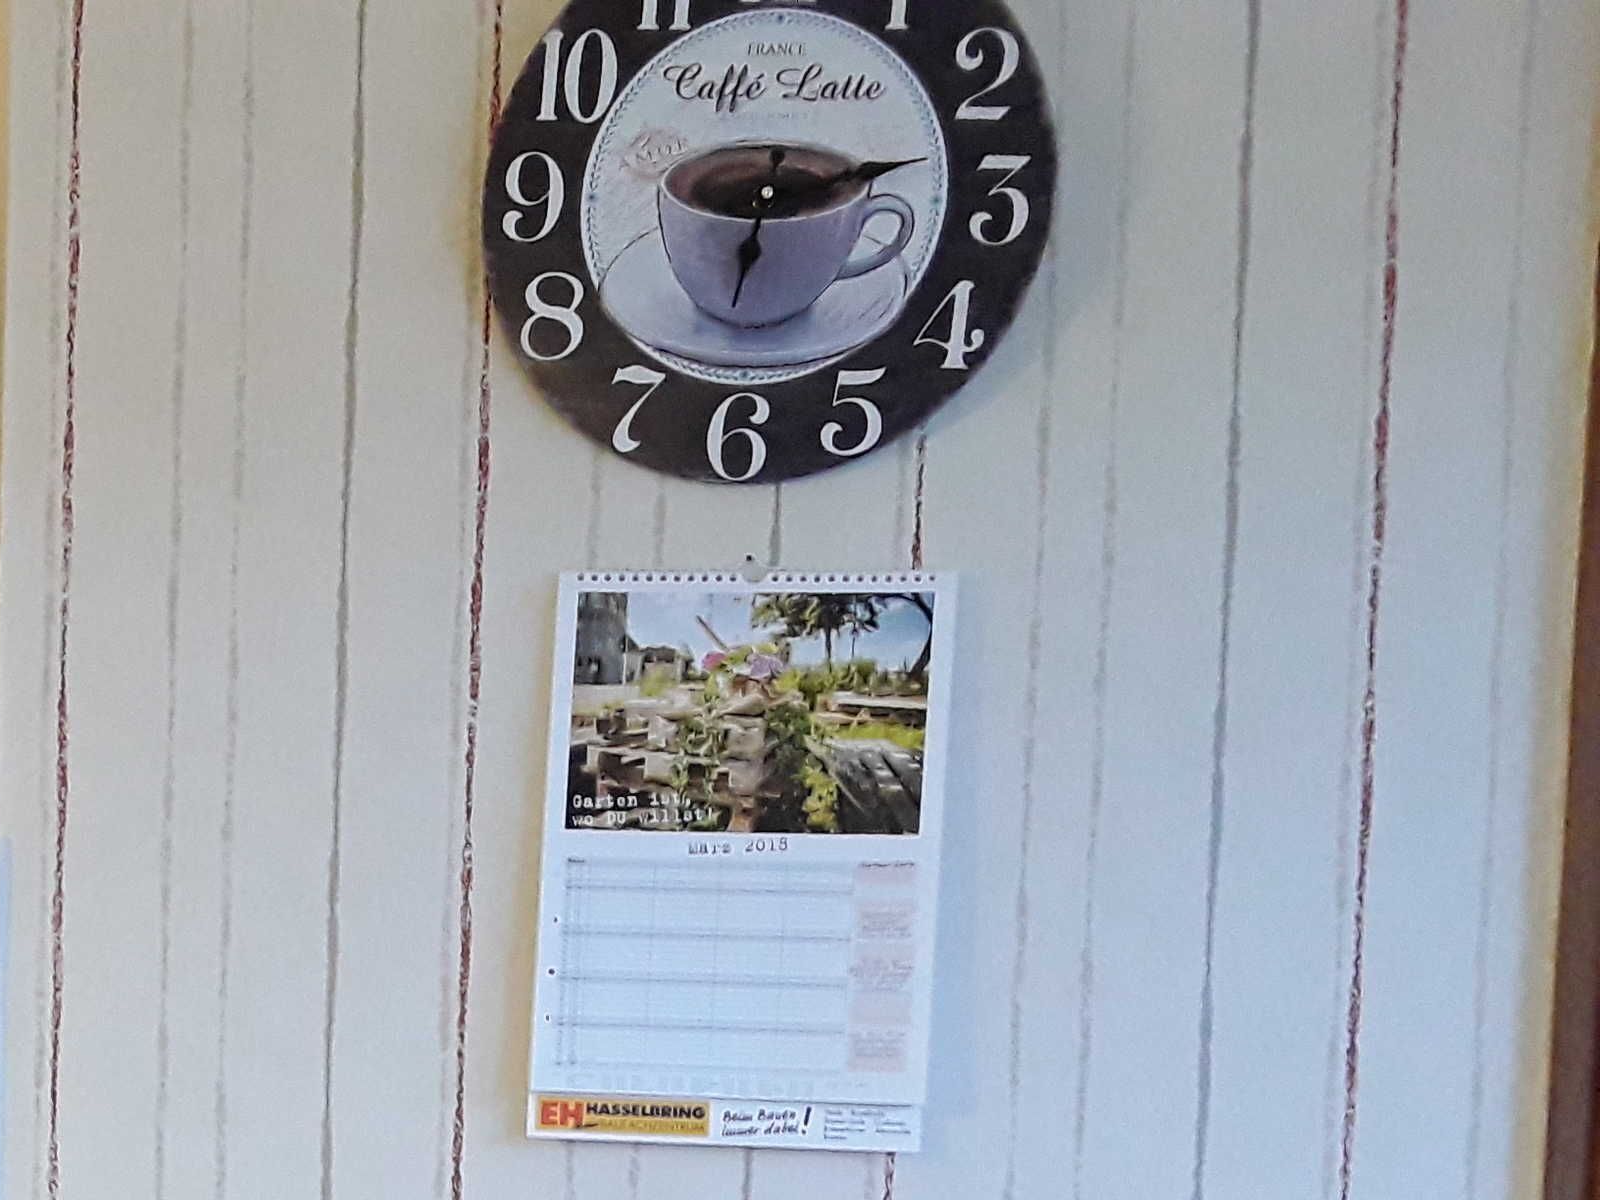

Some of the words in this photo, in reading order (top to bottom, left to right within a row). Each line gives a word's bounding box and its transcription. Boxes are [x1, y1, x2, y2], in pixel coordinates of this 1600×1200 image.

[536, 29, 618, 124] 10
[663, 63, 766, 113] Caffé
[776, 63, 886, 102] Latte
[747, 41, 807, 56] FRANCE
[955, 28, 1020, 121] 2
[502, 151, 565, 243] 9
[969, 154, 1032, 246] 3
[520, 271, 585, 361] 8
[913, 279, 985, 370] 4
[611, 364, 666, 453] 7
[706, 392, 767, 482] 6
[819, 366, 887, 456] 5
